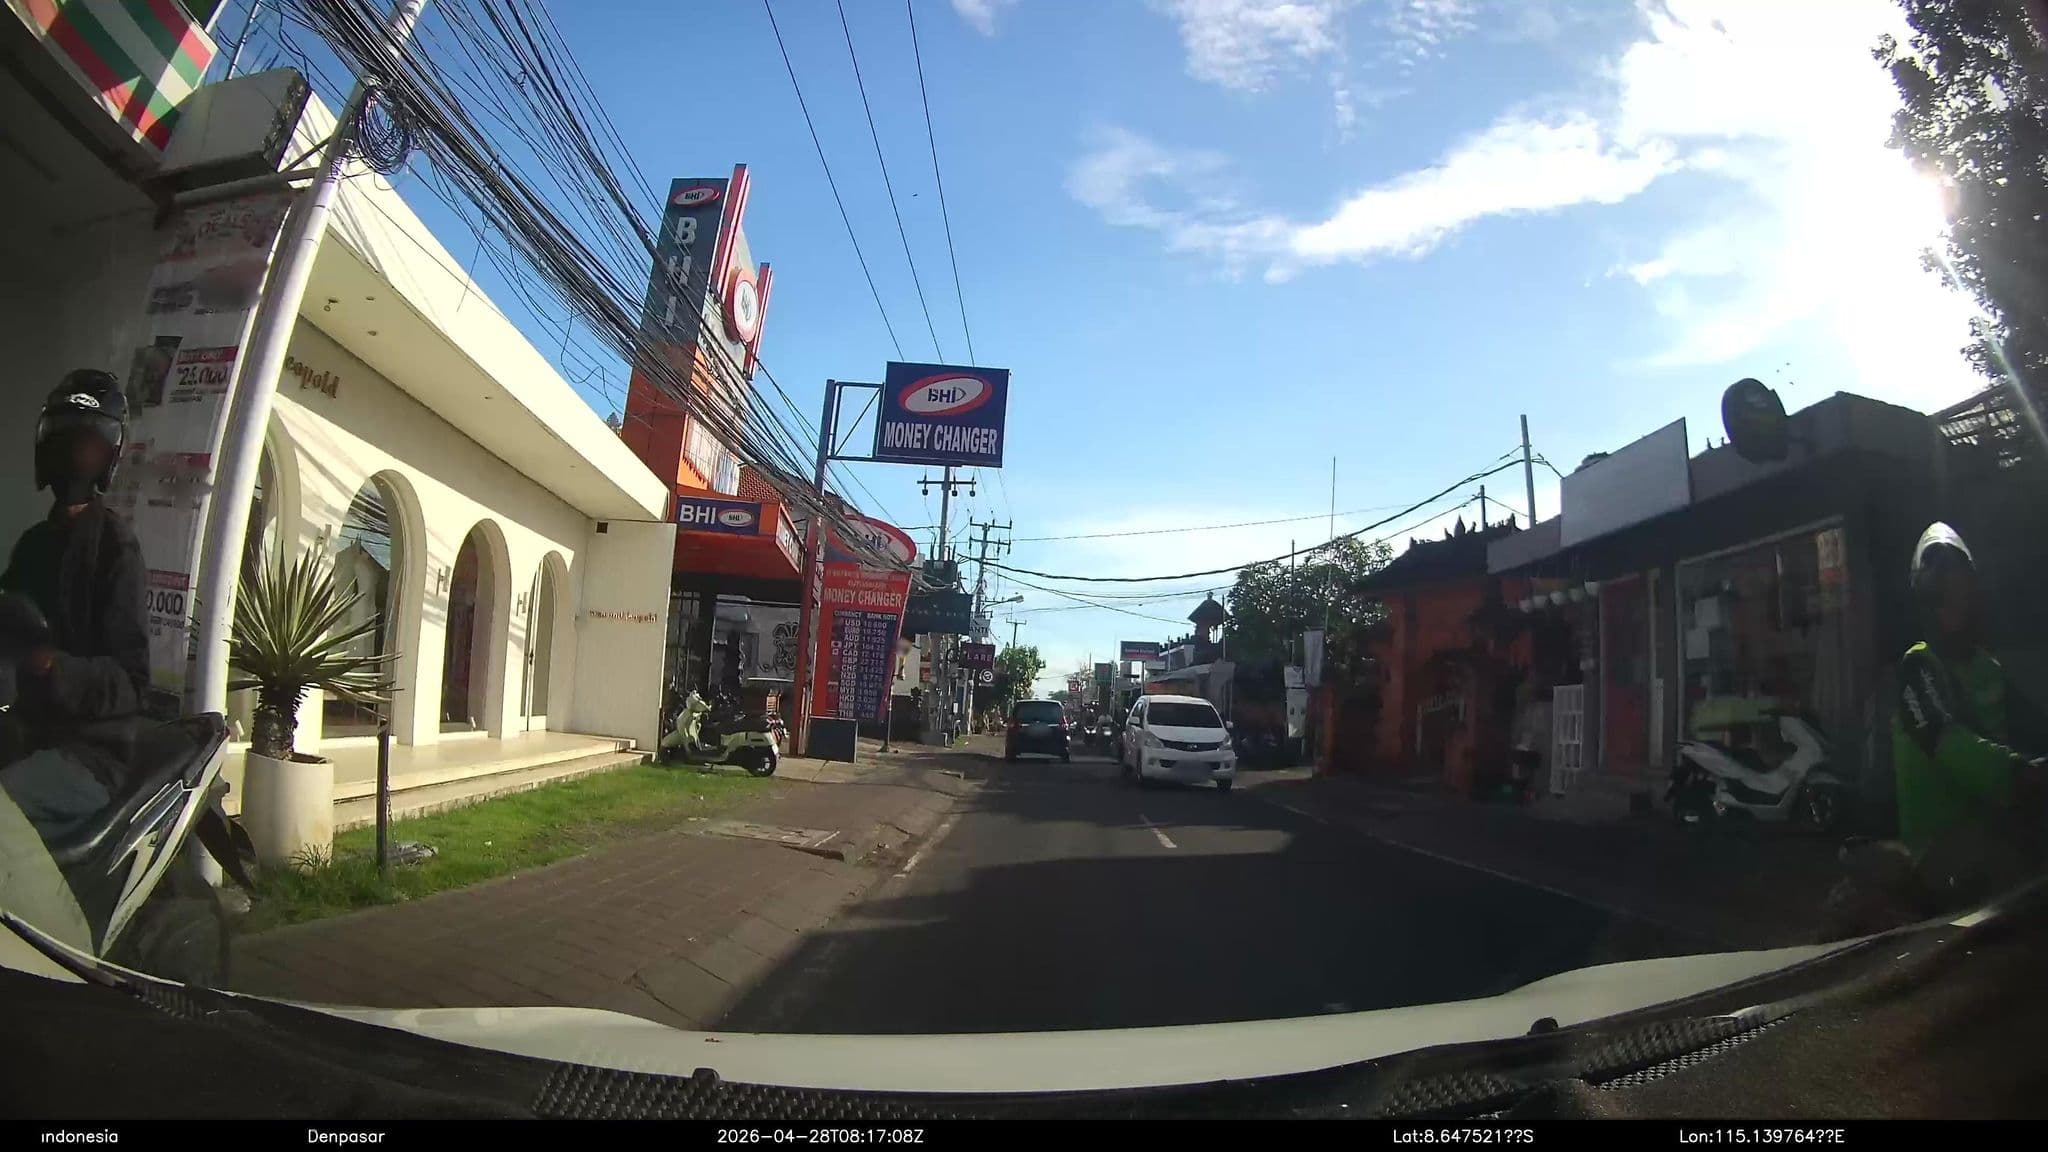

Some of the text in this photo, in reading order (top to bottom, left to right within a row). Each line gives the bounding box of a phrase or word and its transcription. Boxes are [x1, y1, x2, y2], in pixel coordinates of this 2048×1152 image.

[285, 355, 340, 398] eopold
[883, 421, 998, 455] MONEY CHANGER
[679, 503, 716, 525] BHI
[823, 588, 902, 608] MONEY CHANGER
[845, 619, 861, 627] USD
[844, 634, 860, 642] AUD
[843, 641, 859, 649] JPY
[842, 649, 859, 657] CAD
[841, 664, 857, 672] CHF
[840, 671, 857, 679] NZD
[839, 694, 855, 702] HKD
